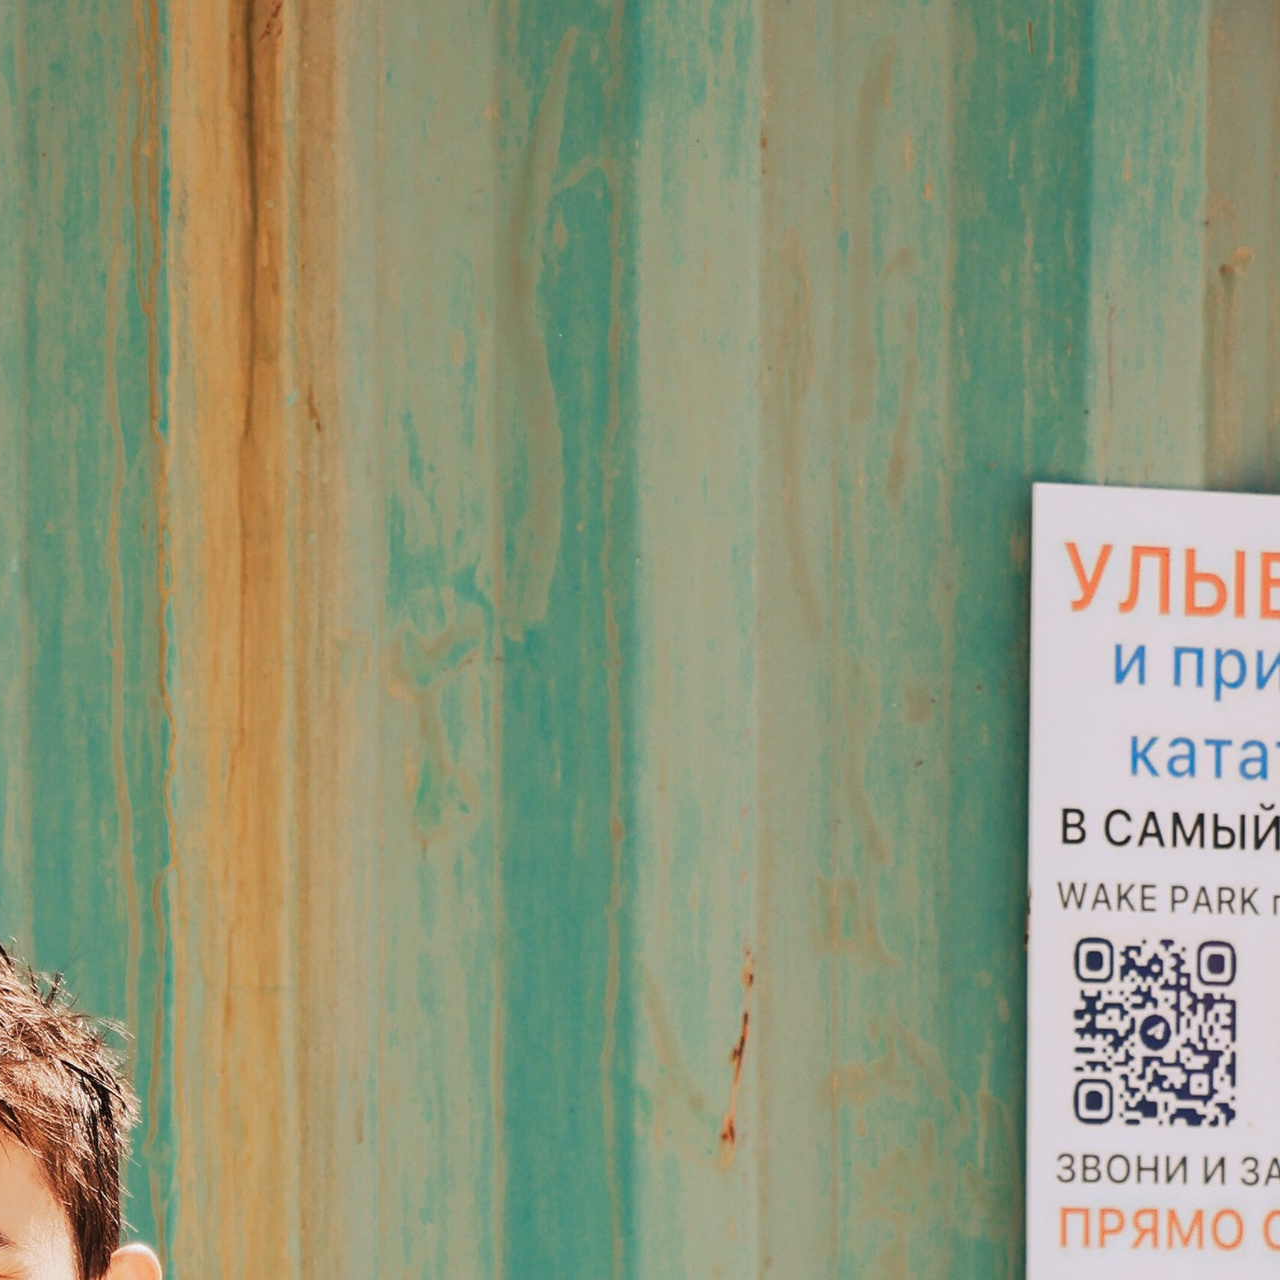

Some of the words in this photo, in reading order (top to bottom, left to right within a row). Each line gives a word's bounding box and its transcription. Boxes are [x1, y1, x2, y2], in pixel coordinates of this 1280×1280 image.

[1114, 643, 1147, 687] и
[1172, 645, 1280, 703] при
[1130, 735, 1280, 782] ката
[1060, 807, 1087, 846] В
[1103, 802, 1280, 852] САМЫЙ
[1056, 880, 1157, 913] WAKE
[1169, 884, 1260, 916] PARK
[1056, 1152, 1188, 1186] ЗВОНИ
[1202, 1155, 1226, 1186] И
[1059, 1206, 1245, 1252] ПРЯМО
